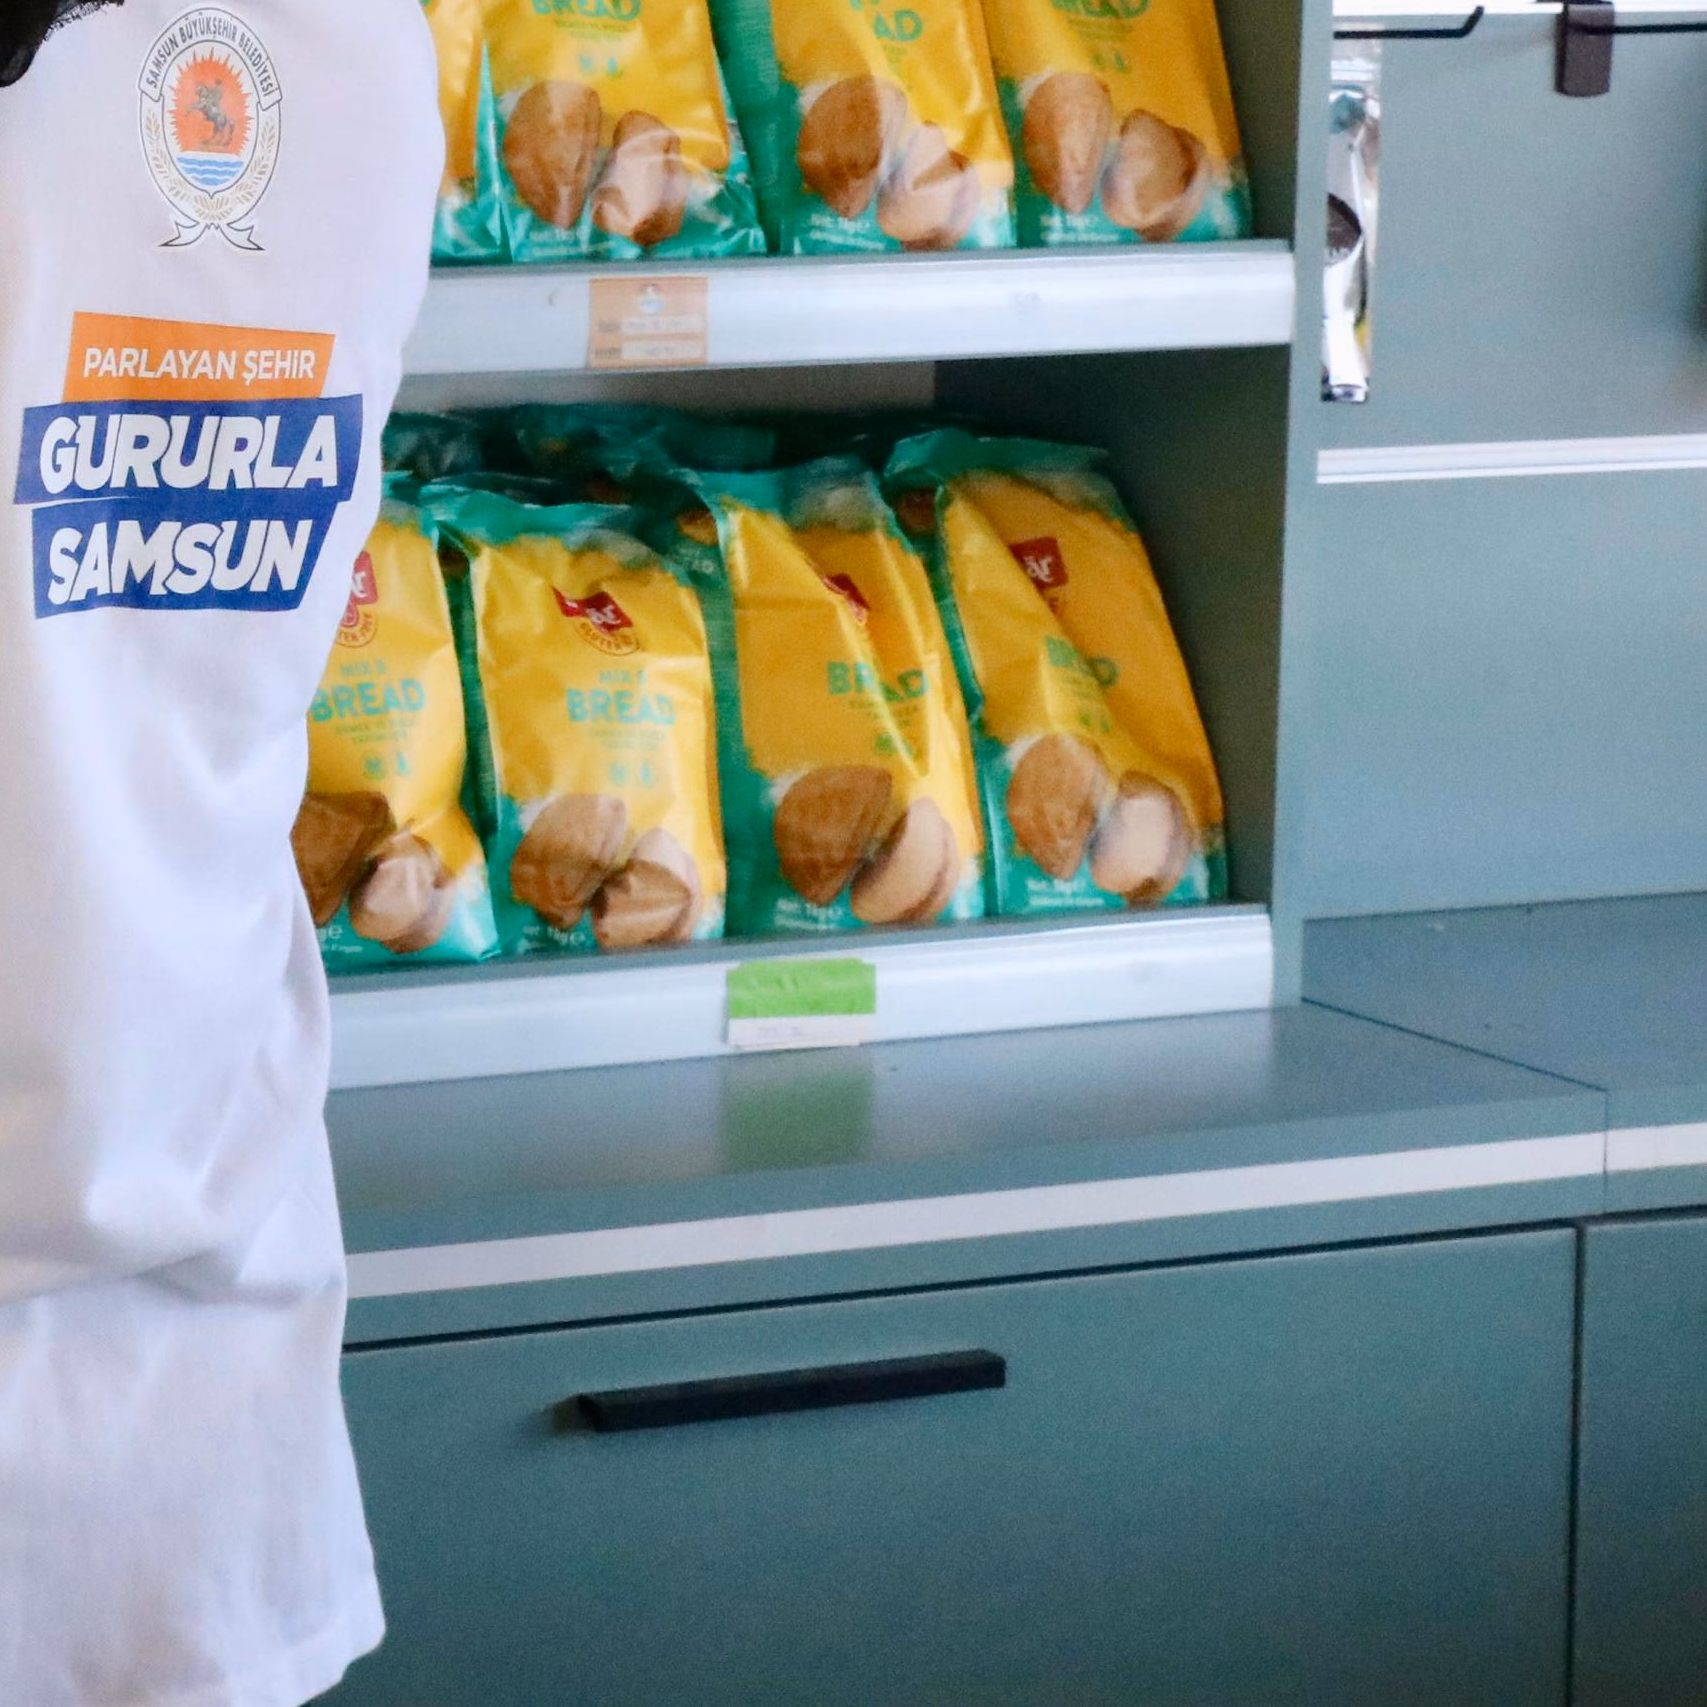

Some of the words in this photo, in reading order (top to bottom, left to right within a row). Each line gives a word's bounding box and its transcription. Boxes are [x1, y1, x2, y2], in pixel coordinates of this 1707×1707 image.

[146, 34, 179, 89] SAMSUN
[179, 12, 238, 44] BÜYÜKŞEHİR
[239, 32, 279, 96] BELEDİYESİ
[83, 345, 238, 381] PARLAYAN
[243, 347, 316, 383] ŞEHİR
[38, 413, 338, 493] GURURLA
[49, 519, 313, 605] SAMSUN
[308, 678, 426, 724] BREAD
[565, 688, 677, 726] BREAD
